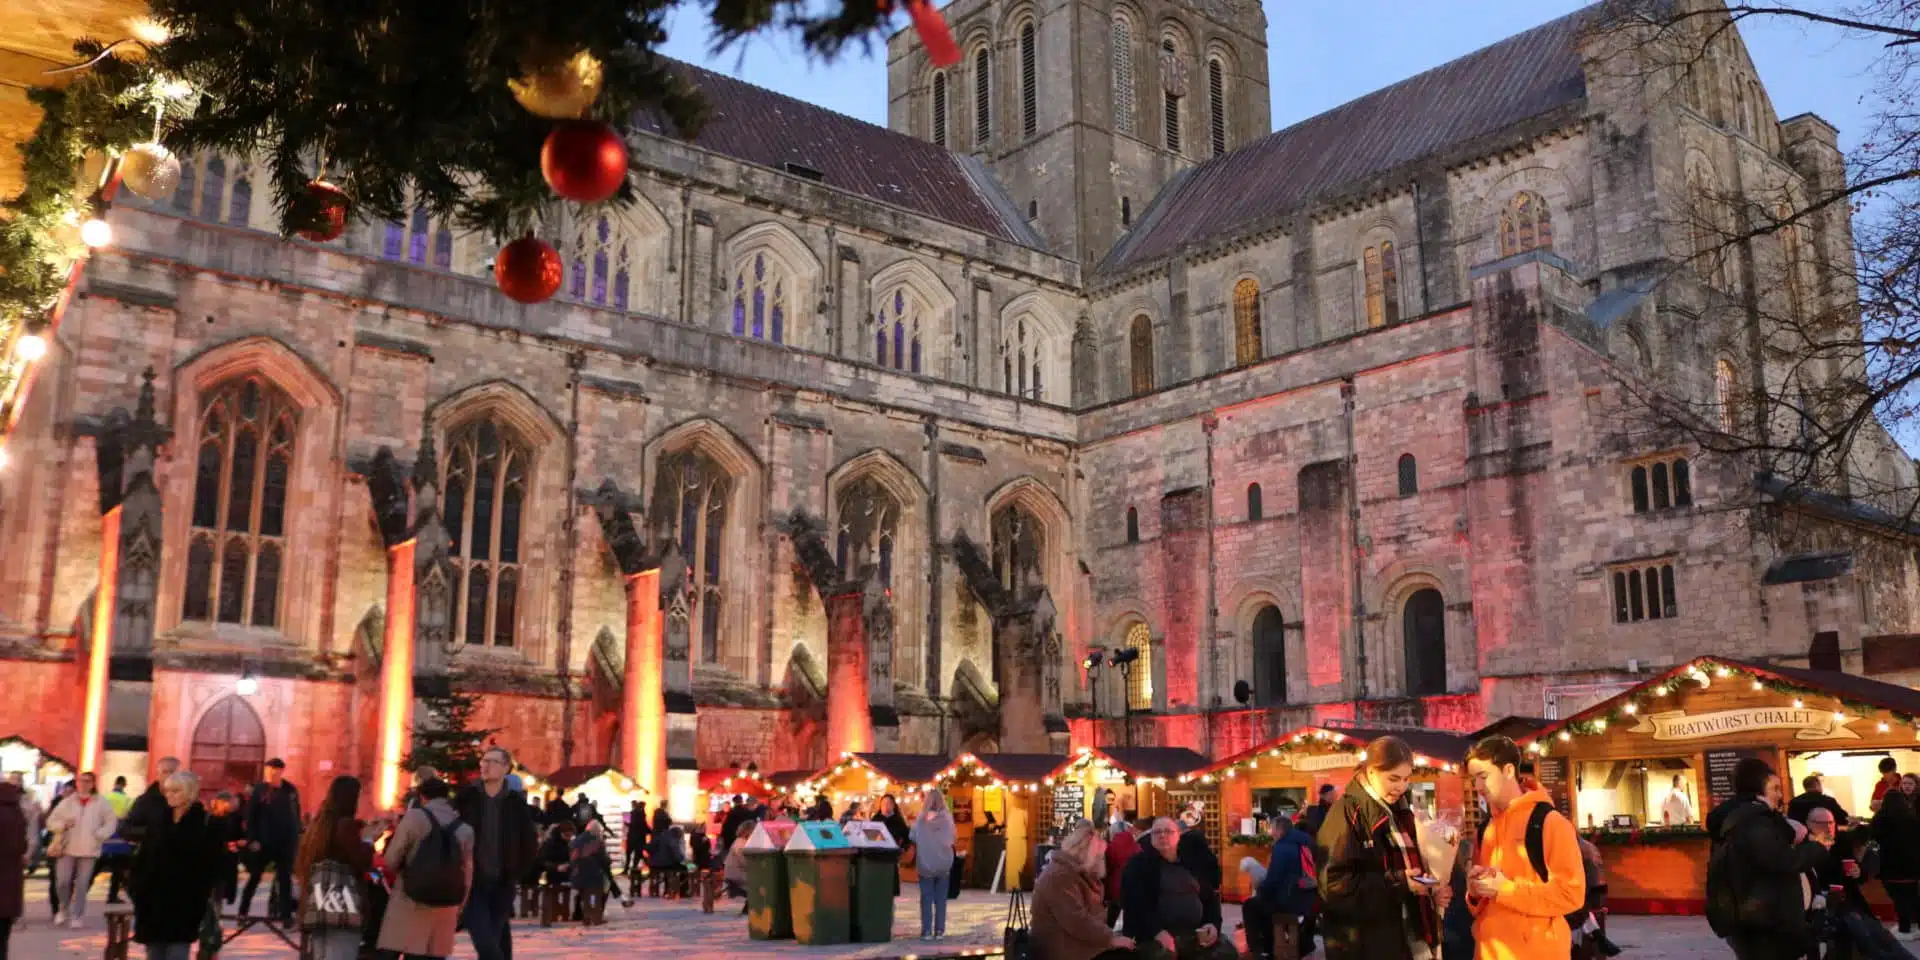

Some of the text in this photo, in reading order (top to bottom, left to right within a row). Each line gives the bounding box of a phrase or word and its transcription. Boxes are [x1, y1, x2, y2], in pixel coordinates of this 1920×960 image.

[1668, 710, 1813, 736] BRATWURST CHALET
[314, 882, 357, 913] V&A
